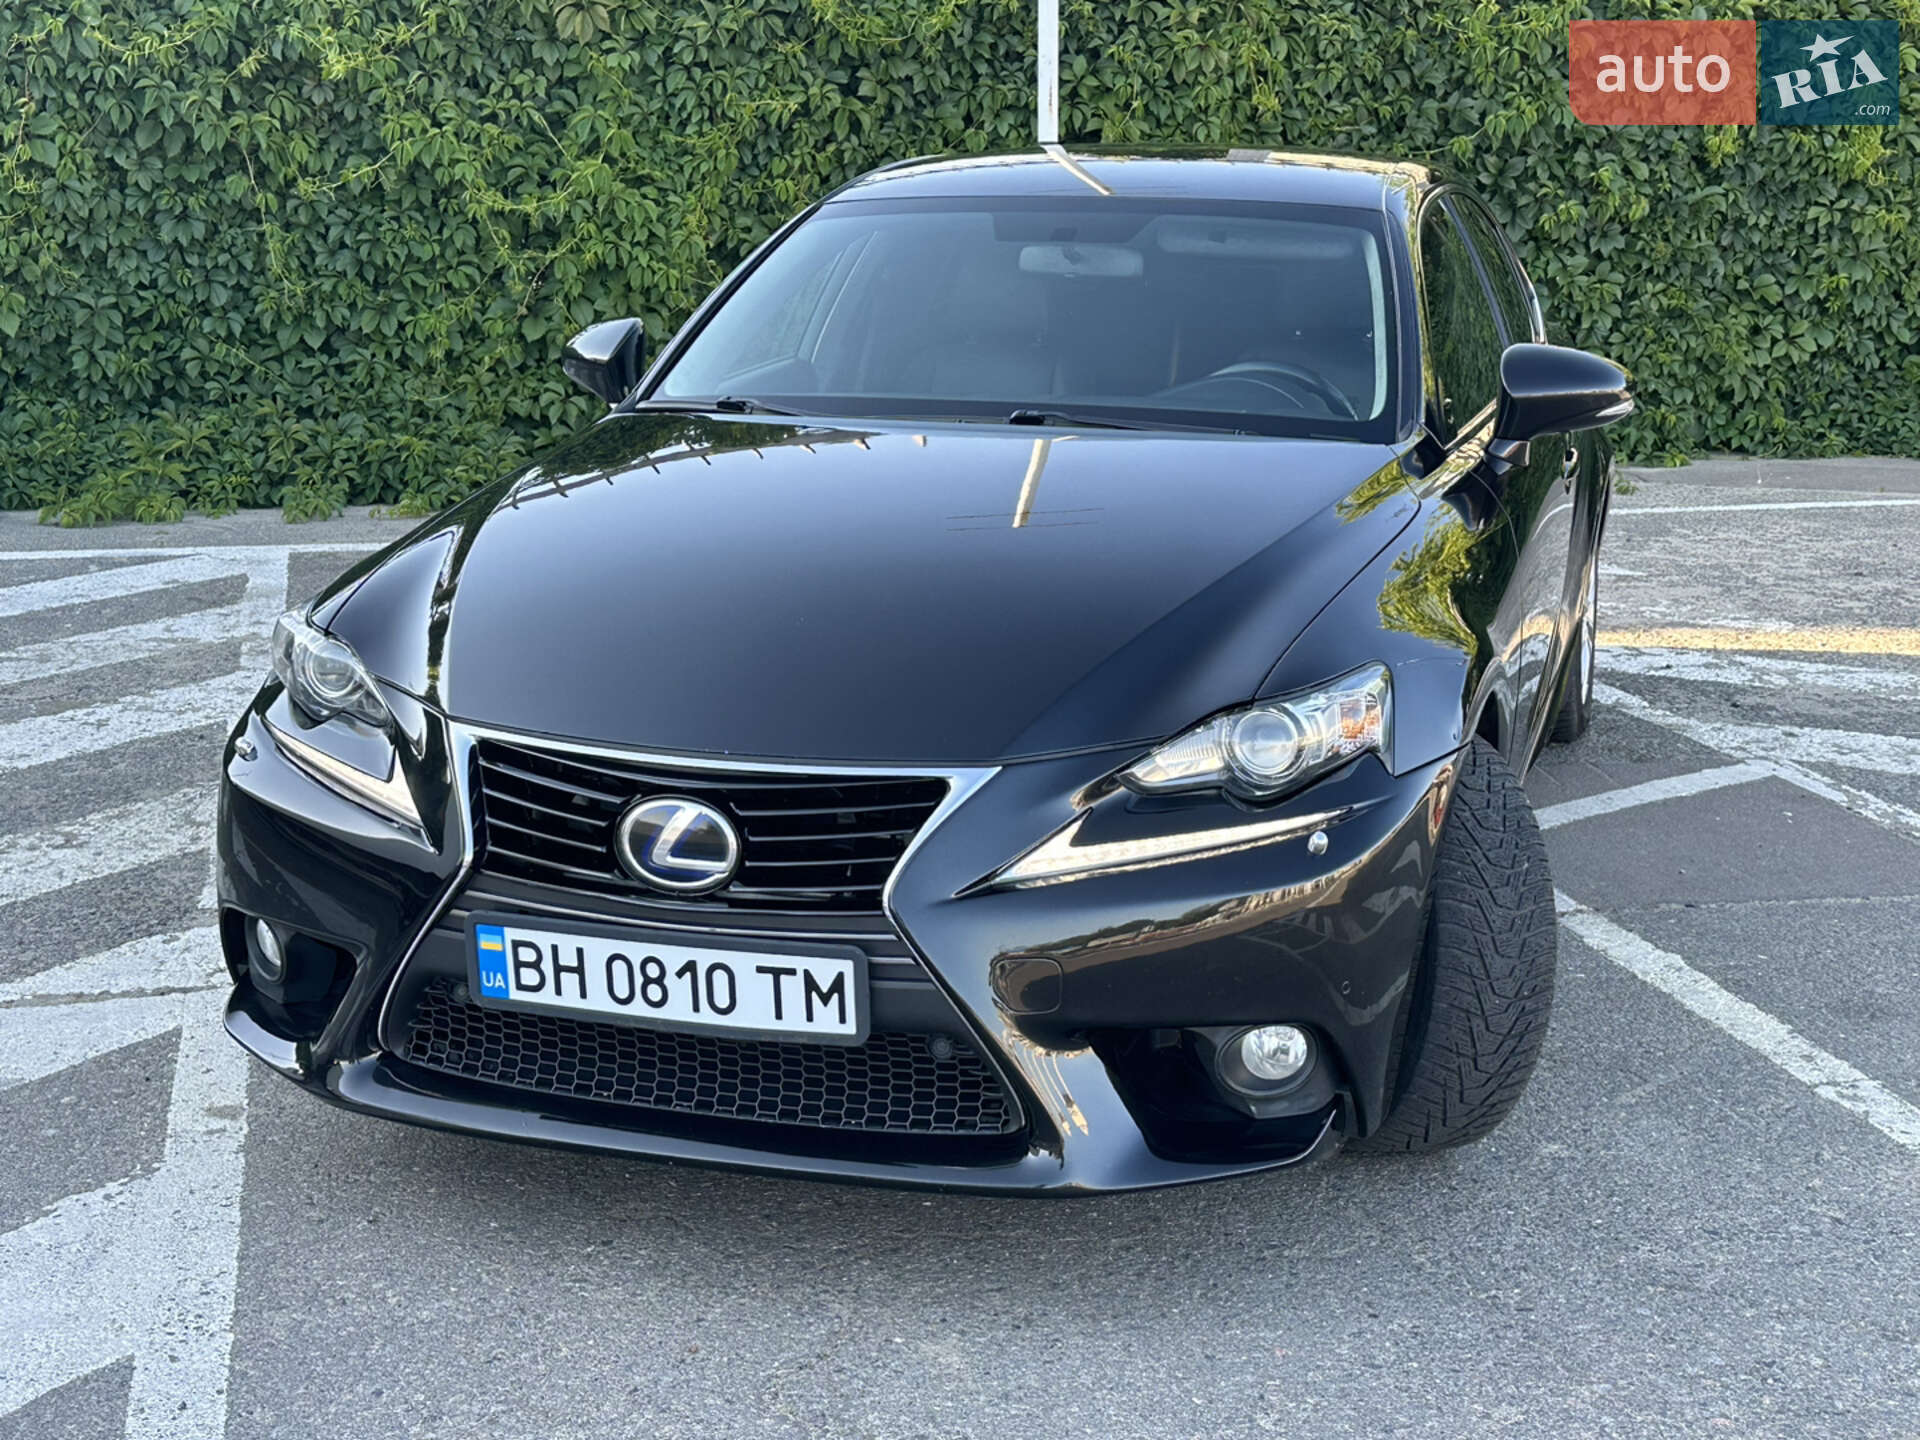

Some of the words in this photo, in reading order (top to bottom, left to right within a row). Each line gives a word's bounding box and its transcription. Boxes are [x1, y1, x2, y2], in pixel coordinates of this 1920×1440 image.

[482, 970, 506, 990] UA
[511, 939, 588, 1000] BH
[605, 953, 737, 1016] 0810
[755, 965, 847, 1024] TM
